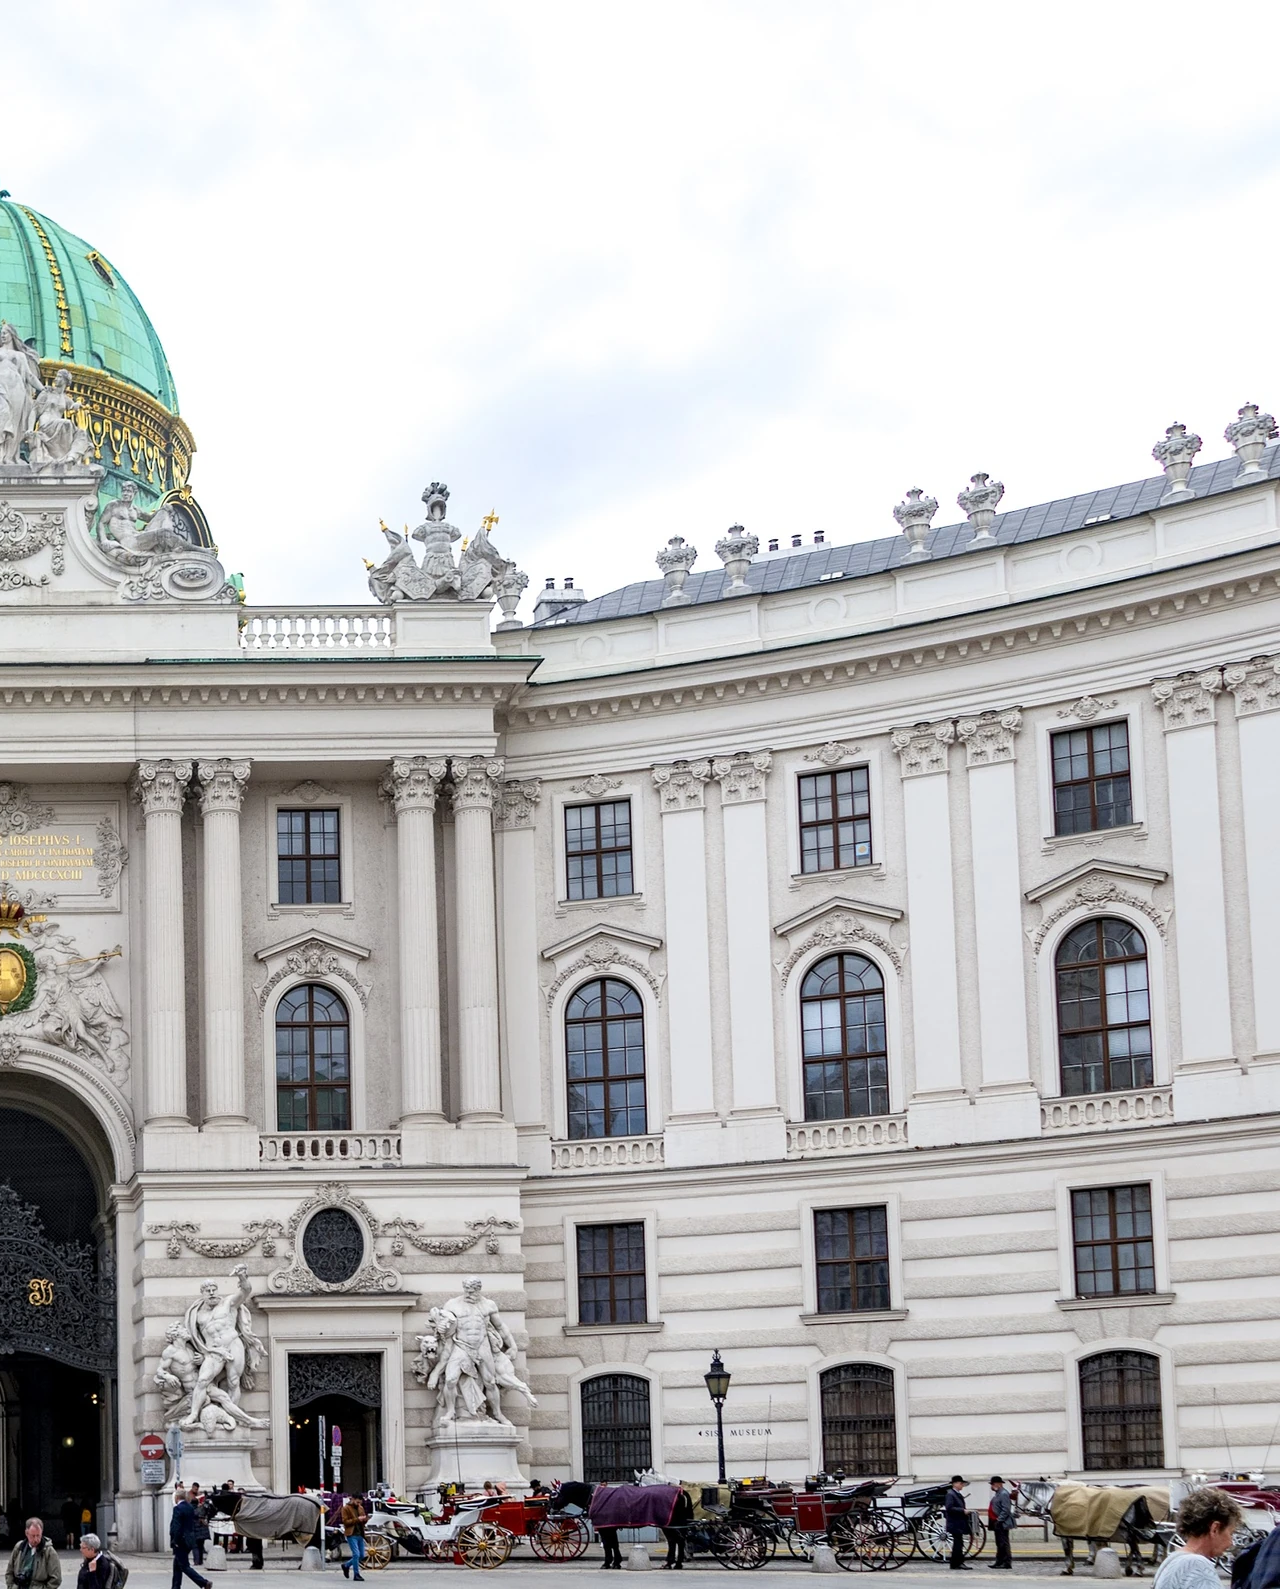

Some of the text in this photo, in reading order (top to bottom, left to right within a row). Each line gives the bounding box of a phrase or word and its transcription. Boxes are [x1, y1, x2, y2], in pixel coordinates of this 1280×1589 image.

[9, 835, 70, 846] IOSEPHVS
[704, 1428, 773, 1438] SIS MUSEUM
